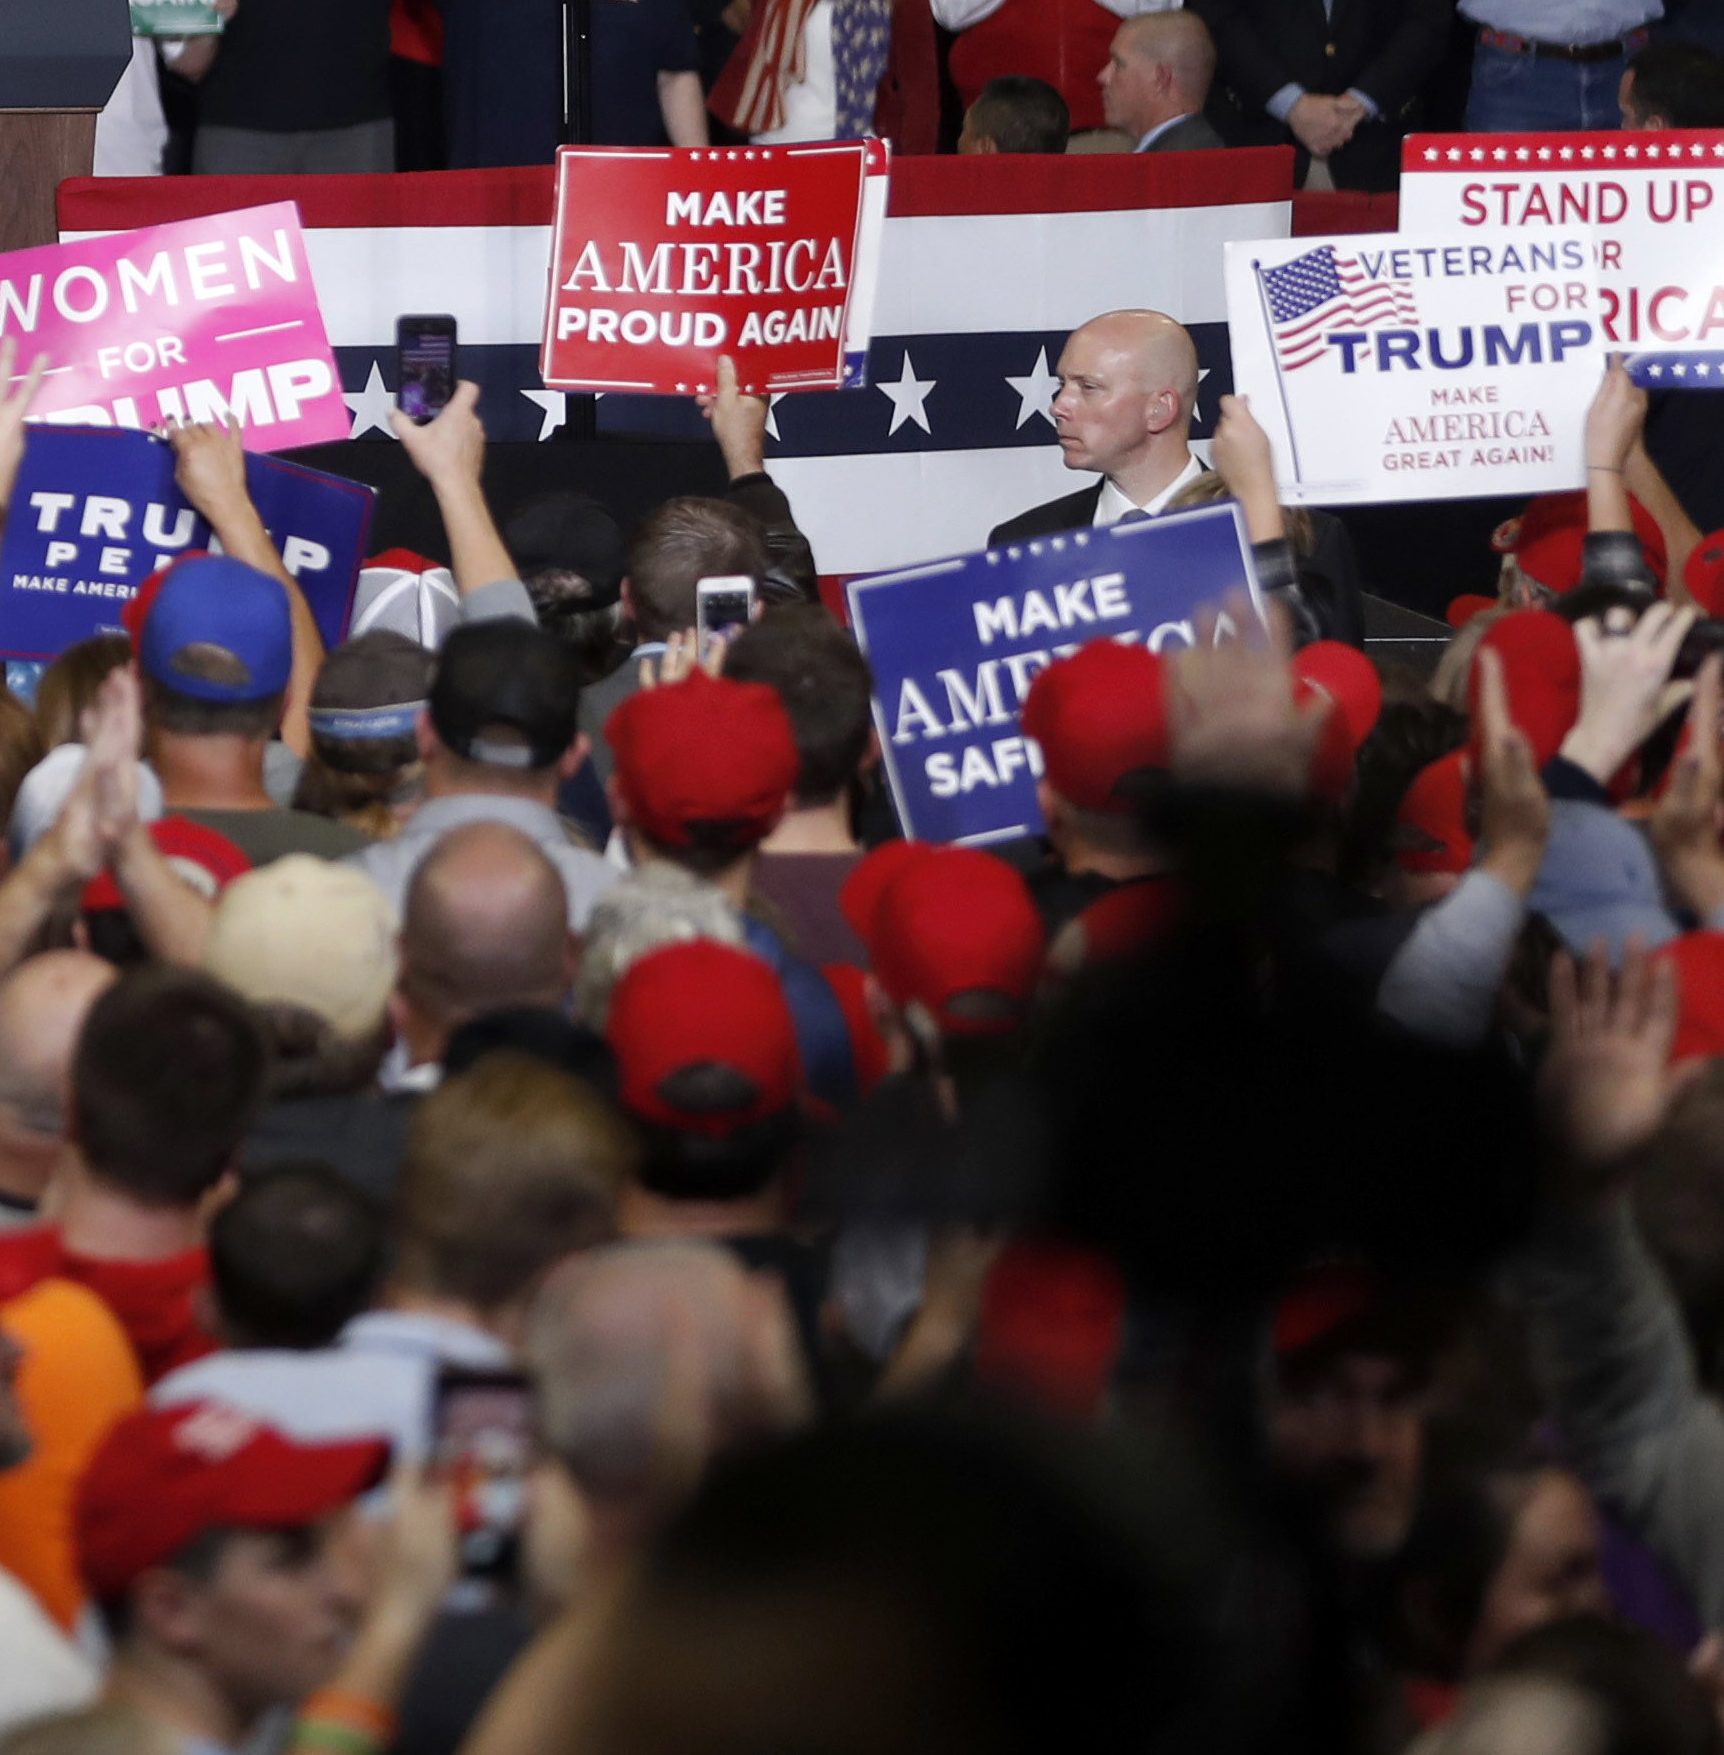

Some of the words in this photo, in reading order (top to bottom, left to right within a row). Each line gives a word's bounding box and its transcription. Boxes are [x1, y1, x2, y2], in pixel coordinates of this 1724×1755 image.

[665, 191, 786, 228] MAKE
[1459, 181, 1628, 227] STAND
[1647, 178, 1715, 224] UP
[563, 225, 848, 294] AMERICA
[1358, 241, 1584, 281] VETERANS
[1505, 282, 1588, 314] FOR
[557, 305, 727, 345] PROUD
[738, 304, 844, 346] AGAIN
[98, 336, 186, 381] FOR
[1327, 320, 1593, 375] TRUMP
[23, 359, 334, 434] RUMP
[1429, 386, 1499, 406] MAKE
[1382, 409, 1552, 445] AMERICA
[1381, 449, 1467, 471] GREAT
[1472, 445, 1554, 467] AGAIN!
[29, 492, 332, 577] TRUP
[13, 574, 68, 597] MAKE
[973, 573, 1130, 645] MAKE
